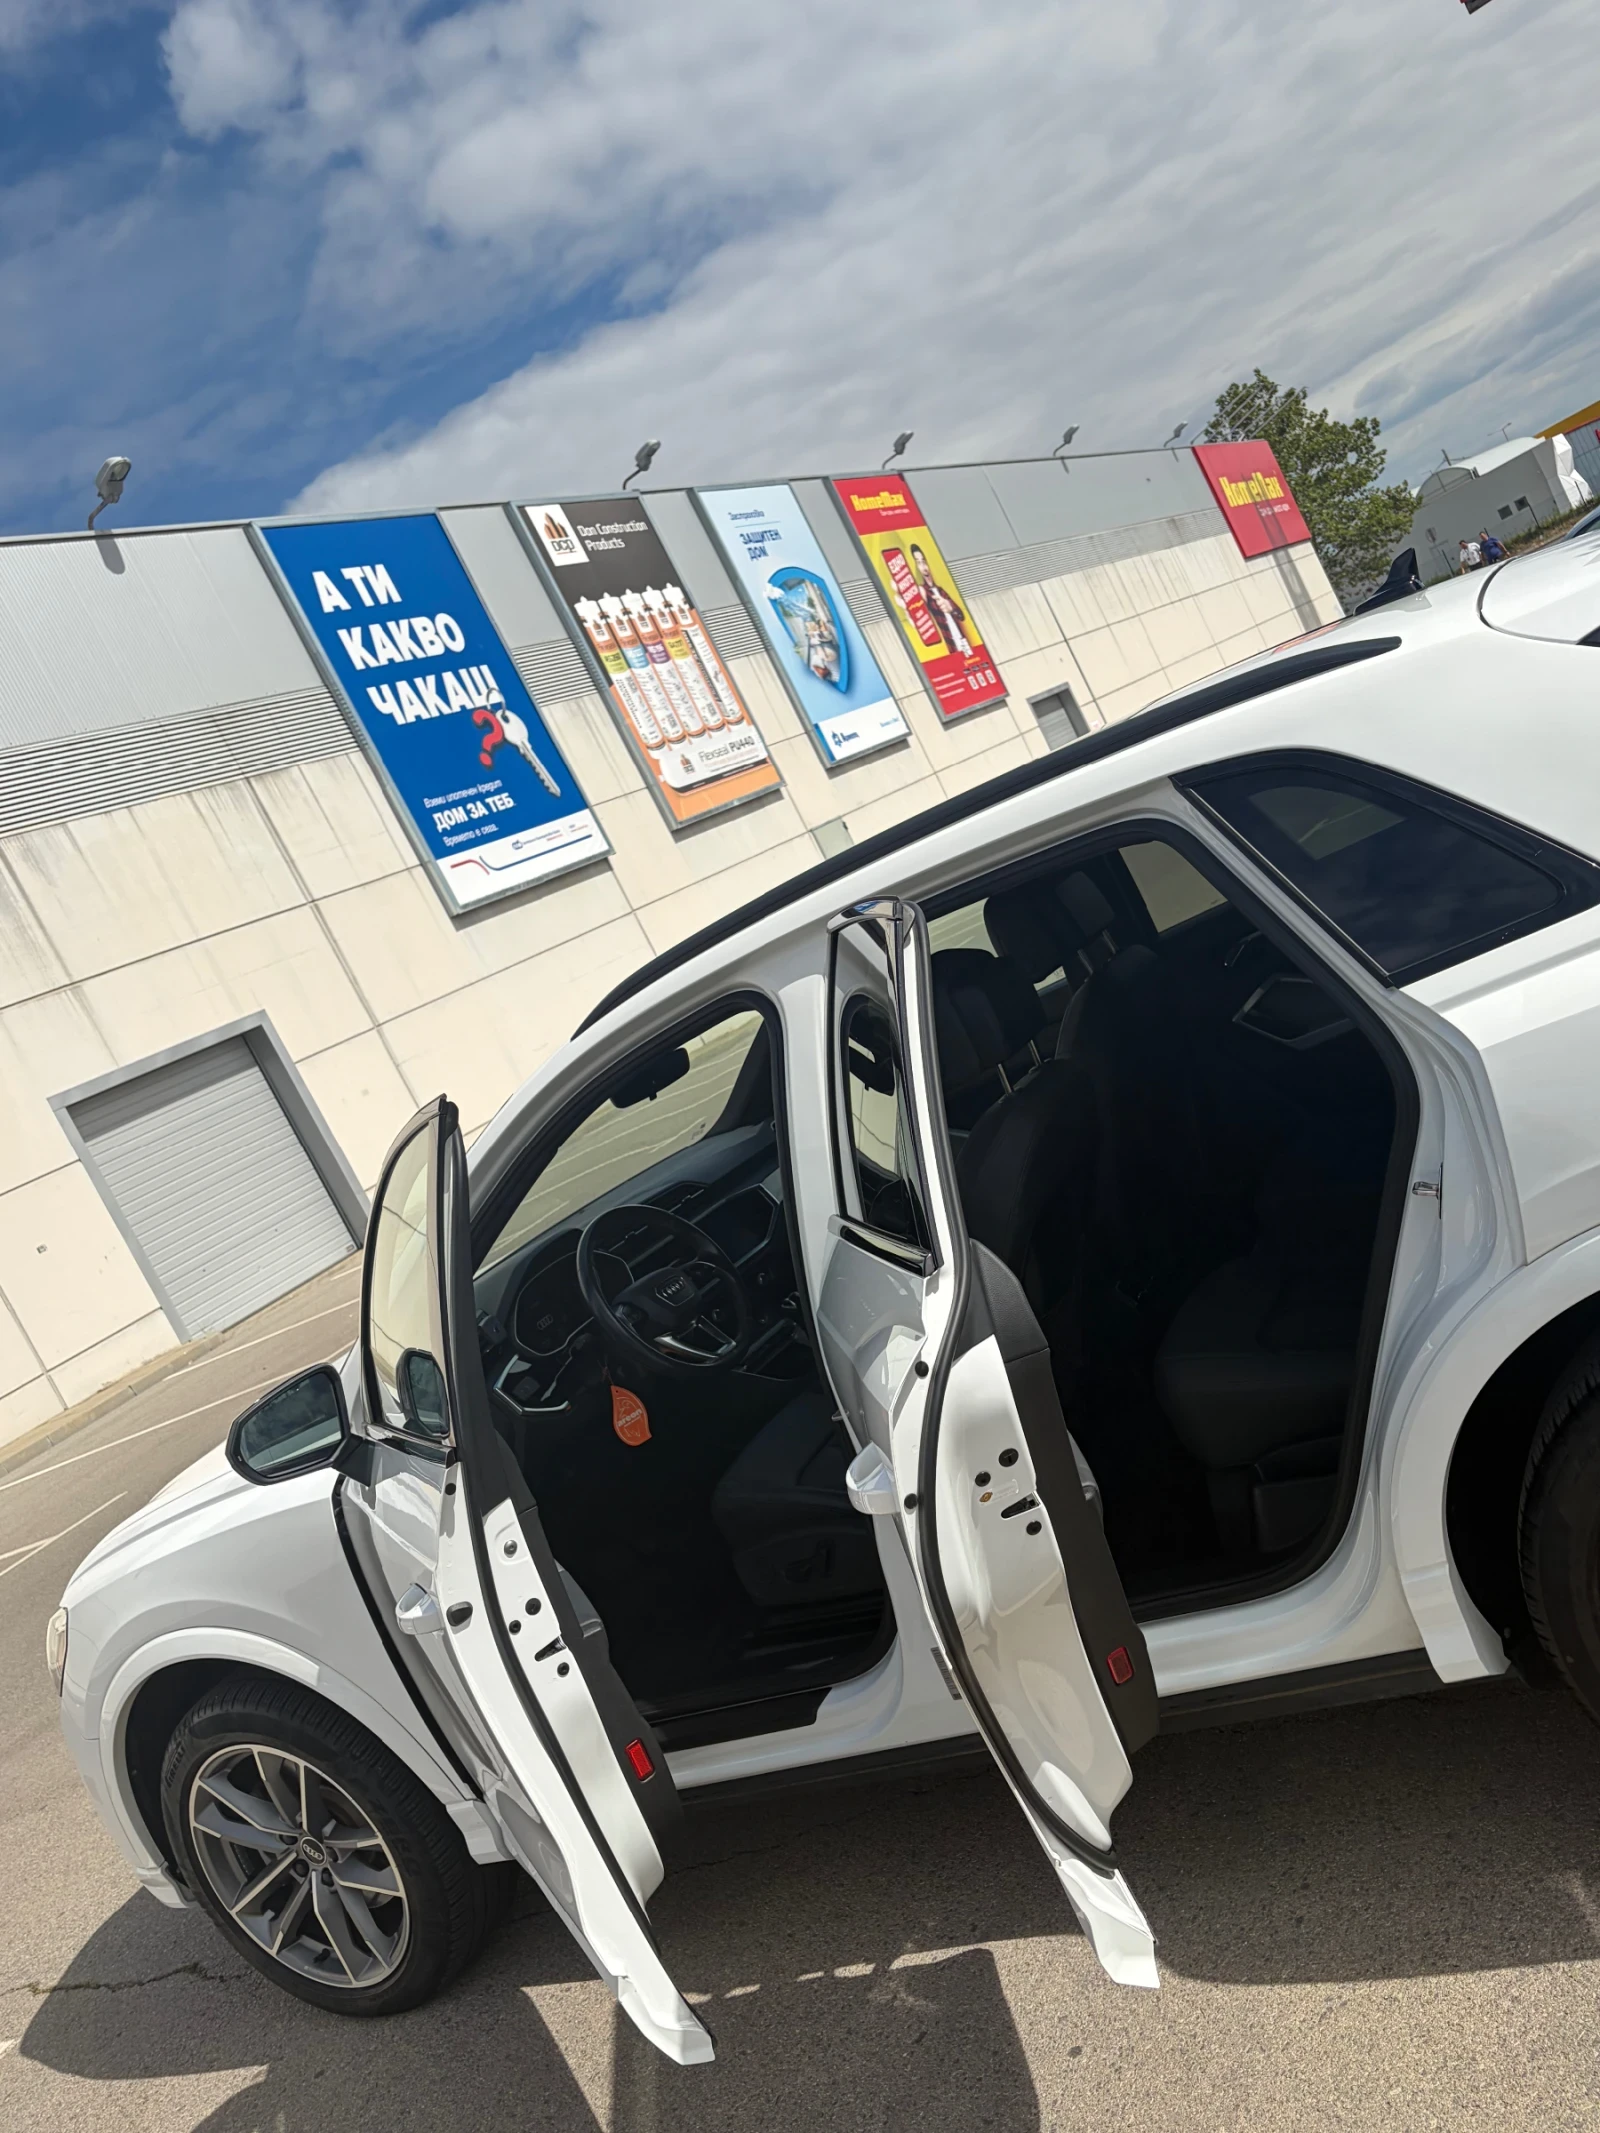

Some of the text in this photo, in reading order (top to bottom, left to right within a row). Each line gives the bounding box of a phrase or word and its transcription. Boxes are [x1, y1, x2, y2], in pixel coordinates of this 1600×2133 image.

[850, 491, 907, 511] HomeMax
[1219, 472, 1284, 507] HomeMax
[577, 520, 648, 536] Don Construction
[740, 529, 782, 544] ЗАЩИТЕН
[585, 538, 625, 551] Products
[747, 546, 769, 561] ДОМ
[312, 564, 402, 613] А ТИ
[337, 613, 465, 670] КАКВО
[366, 664, 502, 725] ЧАКАШ
[698, 744, 730, 762] Flexseal
[728, 736, 755, 752] PU440
[423, 780, 502, 808] Вземи ипотечен кредит
[432, 792, 514, 833] ДОМ ЗА ТЕБ
[443, 831, 475, 847] Времето
[617, 1408, 643, 1427] areon
